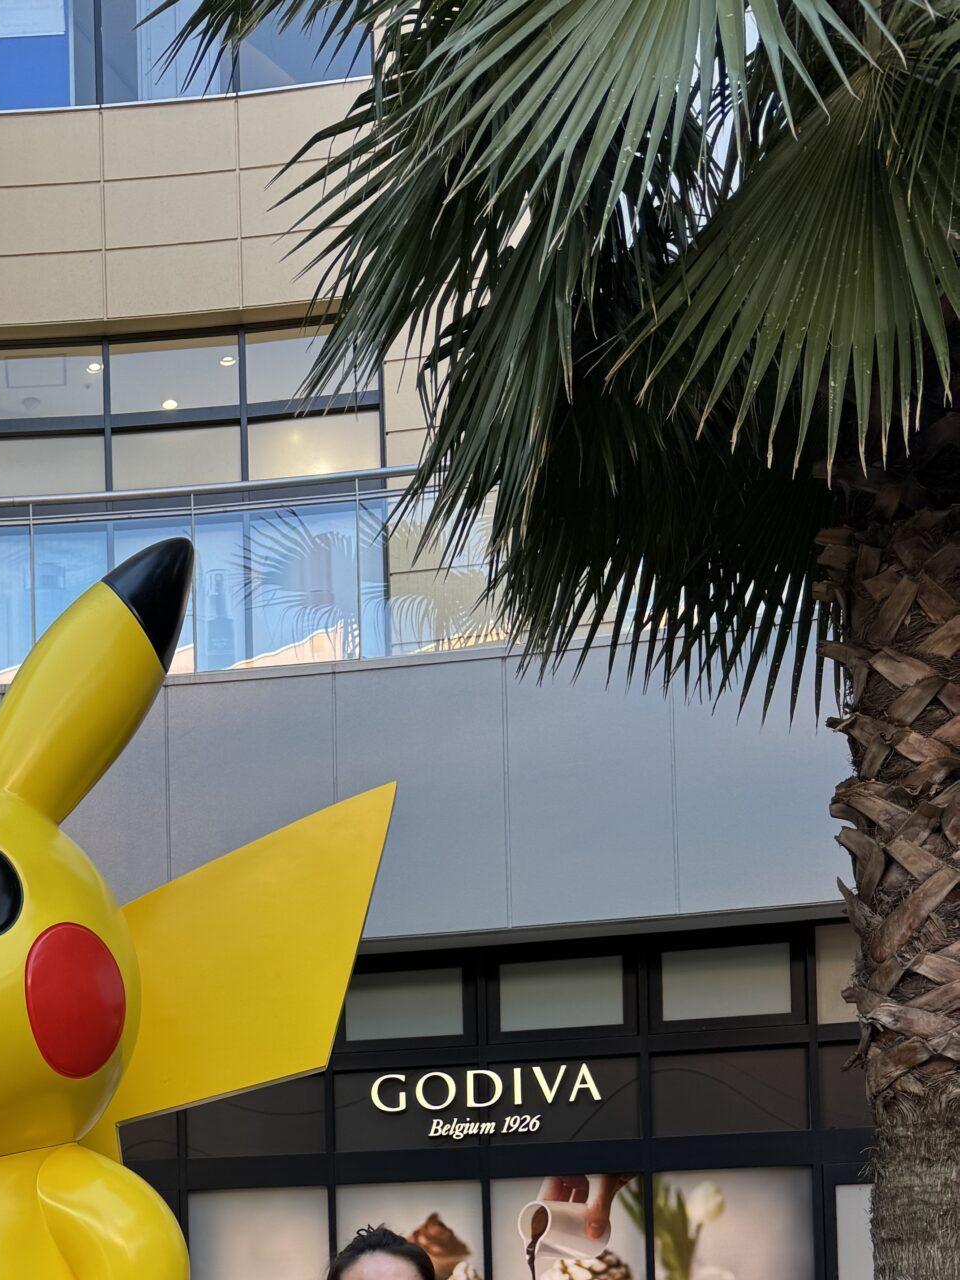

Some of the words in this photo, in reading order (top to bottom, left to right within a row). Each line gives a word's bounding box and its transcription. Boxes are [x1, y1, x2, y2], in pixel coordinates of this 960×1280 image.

[371, 1063, 601, 1112] GODIVA
[428, 1118, 495, 1139] Belgium
[501, 1114, 541, 1133] 1926
